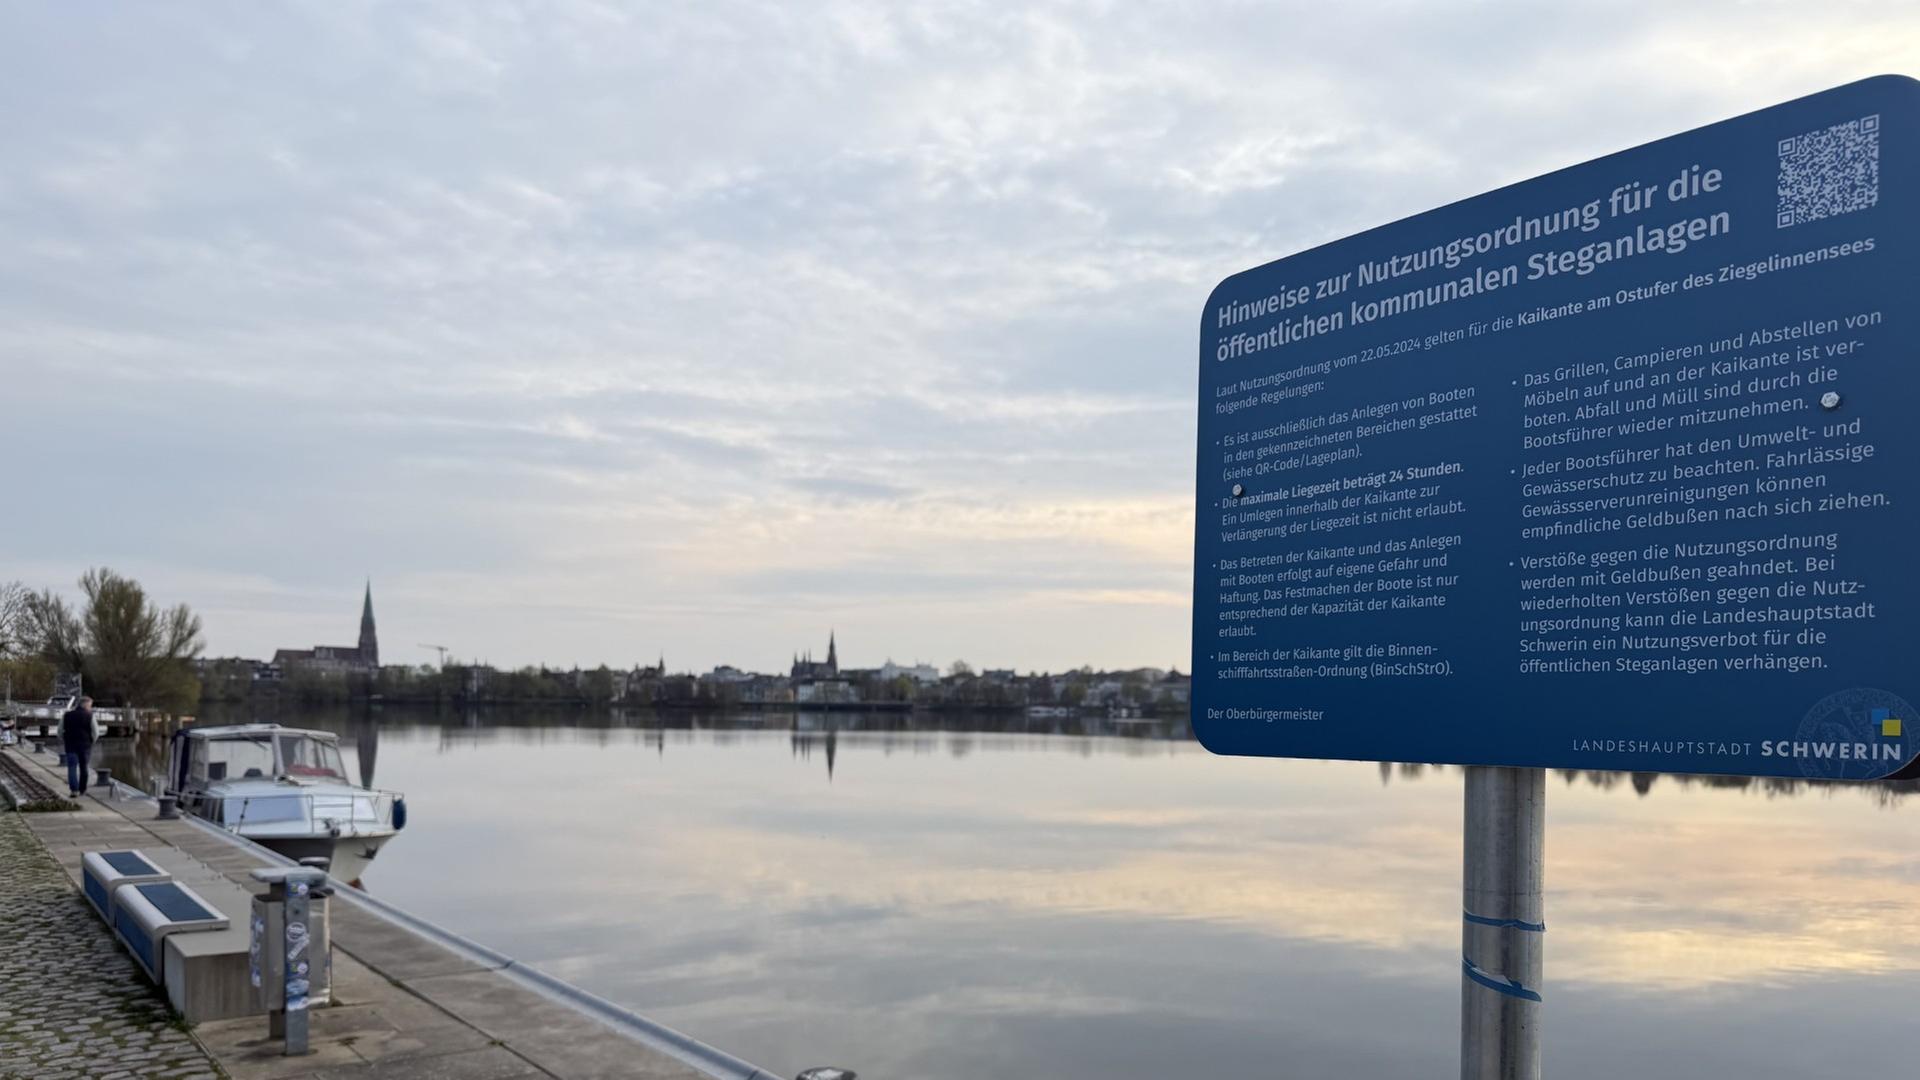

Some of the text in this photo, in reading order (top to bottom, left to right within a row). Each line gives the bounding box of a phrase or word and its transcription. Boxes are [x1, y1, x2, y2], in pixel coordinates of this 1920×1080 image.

[1218, 164, 1722, 329] Hinweise zur Nutzungsordnung für die
[1217, 212, 1730, 362] öffentlichen kommunalen Steganlagen
[1216, 238, 1875, 398] Laut Nutzungsordnung vom 22.05.2024 gelten für die Kaikante am Ostufer des Ziegelinnensees
[1524, 311, 1881, 387] Das Grillen, Campieren und Abstellen von
[1524, 341, 1864, 408] Möbeln auf und an der Kaikante ist ver-
[1216, 381, 1325, 415] folgende Regelungen:
[1524, 365, 1838, 429] boten. Abfall und Müll sind durch die
[1223, 405, 1478, 464] in den gekennzeichneten Bereichen gestattet
[1224, 387, 1475, 447] Es ist ausschließlich das Anlegen von Booten
[1524, 398, 1809, 450] Bootsführer wieder mitzunehmen.
[1223, 443, 1363, 483] (siehe QR-Code/Lageplan).
[1522, 417, 1861, 479] Jeder Bootsführer hat den Umwelt- und
[1222, 461, 1464, 509] Die maximale Liegezeit beträgt 24 Stunden.
[1522, 443, 1875, 498] Gewässerschutz zu beachten. Fahrlässige
[1756, 475, 1826, 494] können
[1221, 500, 1466, 543] Verlängerung der Liegezeit ist nicht erlaubt.
[1222, 485, 1441, 526] Ein Umlegen innerhalb der Kaikante zur
[1522, 492, 1890, 540] empfindliche Geldbußen nach sich ziehen.
[1220, 535, 1462, 571] Das Betreten der Kaikante und das Anlegen
[1520, 533, 1838, 569] Verstöße gegen die Nutzungsordnung
[1220, 553, 1448, 587] mit Booten erfolgt auf eigene Gefahr und
[1521, 554, 1835, 590] werden mit Geldbußen geahndet. Bei
[1220, 574, 1459, 605] Haftung. Das Festmachen der Boote ist nur
[1520, 580, 1865, 611] wiederholten Verstößen gegen die Nutz-
[1219, 594, 1446, 622] entsprechend der Kapazität der Kaikante
[1521, 602, 1876, 635] ungsordnung kann die Landeshauptstadt
[1218, 624, 1257, 638] erlaubt.
[1520, 628, 1826, 653] Schwerin ein Nutzungsverbot für die
[1218, 643, 1438, 662] Im Bereich der Kaikante gilt die Binnen-
[1218, 660, 1454, 680] schifffahrtsstraßen-Ordnung (BinSchStrO).
[1520, 653, 1828, 675] öffentlichen Steganlagen verhängen.
[1207, 707, 1324, 723] Der Oberbürgermeister
[1573, 740, 1901, 761] LANDESHAUPTSTADT SCHWERIN
